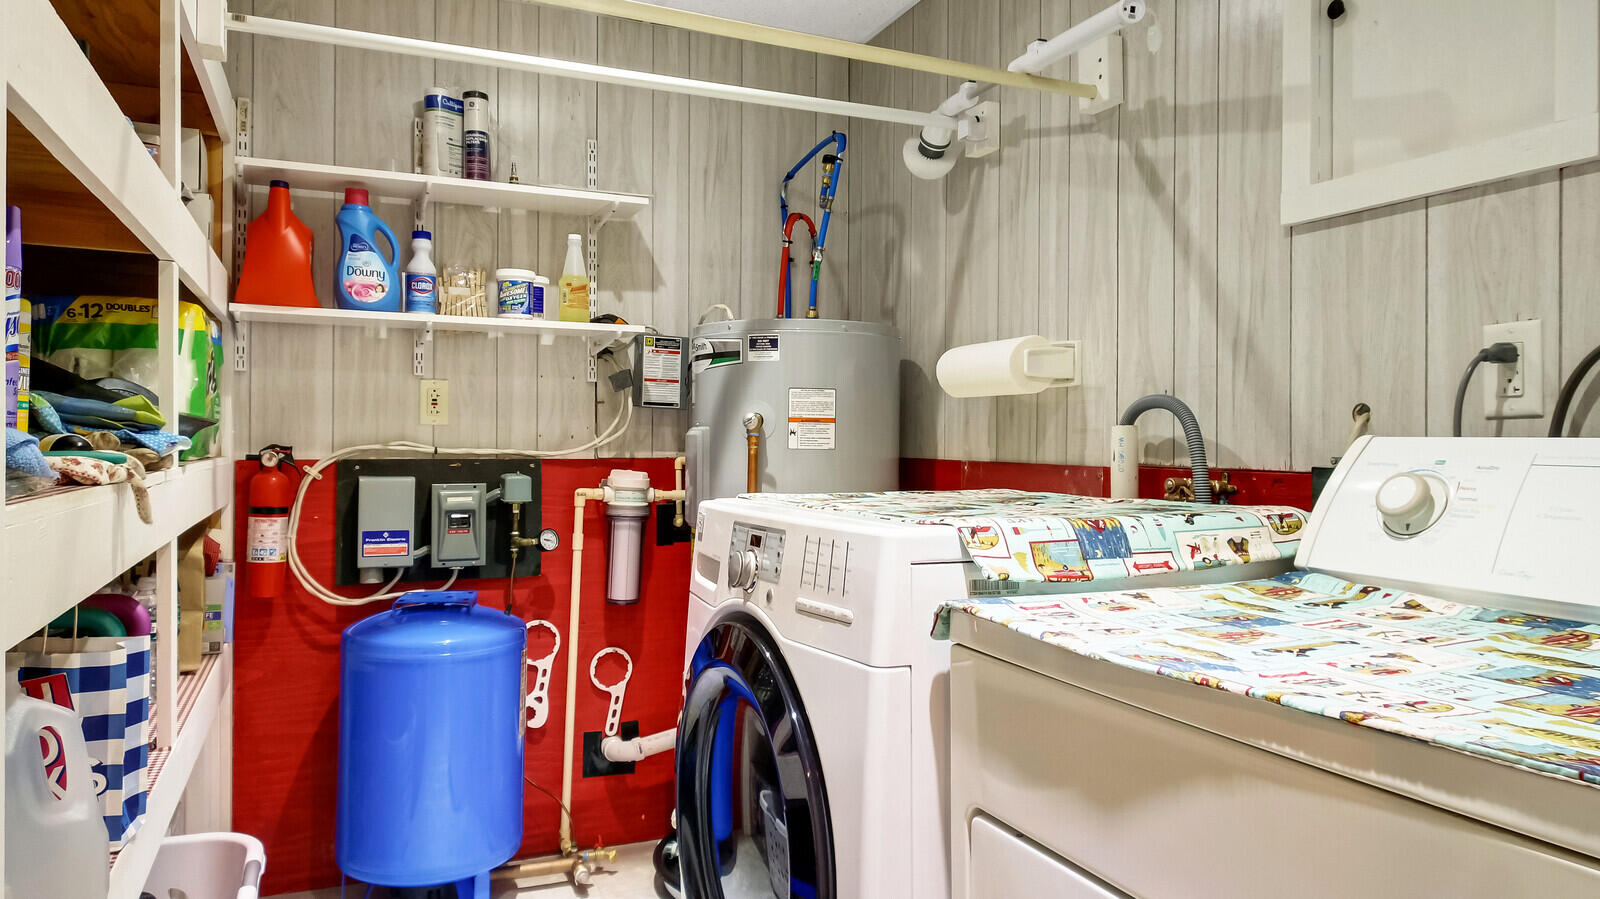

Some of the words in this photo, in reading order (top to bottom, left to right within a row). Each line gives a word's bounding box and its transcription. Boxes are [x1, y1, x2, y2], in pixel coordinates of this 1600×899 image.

[346, 265, 386, 282] Downy
[411, 281, 433, 291] CLOROX
[105, 302, 151, 313] DOUBLES
